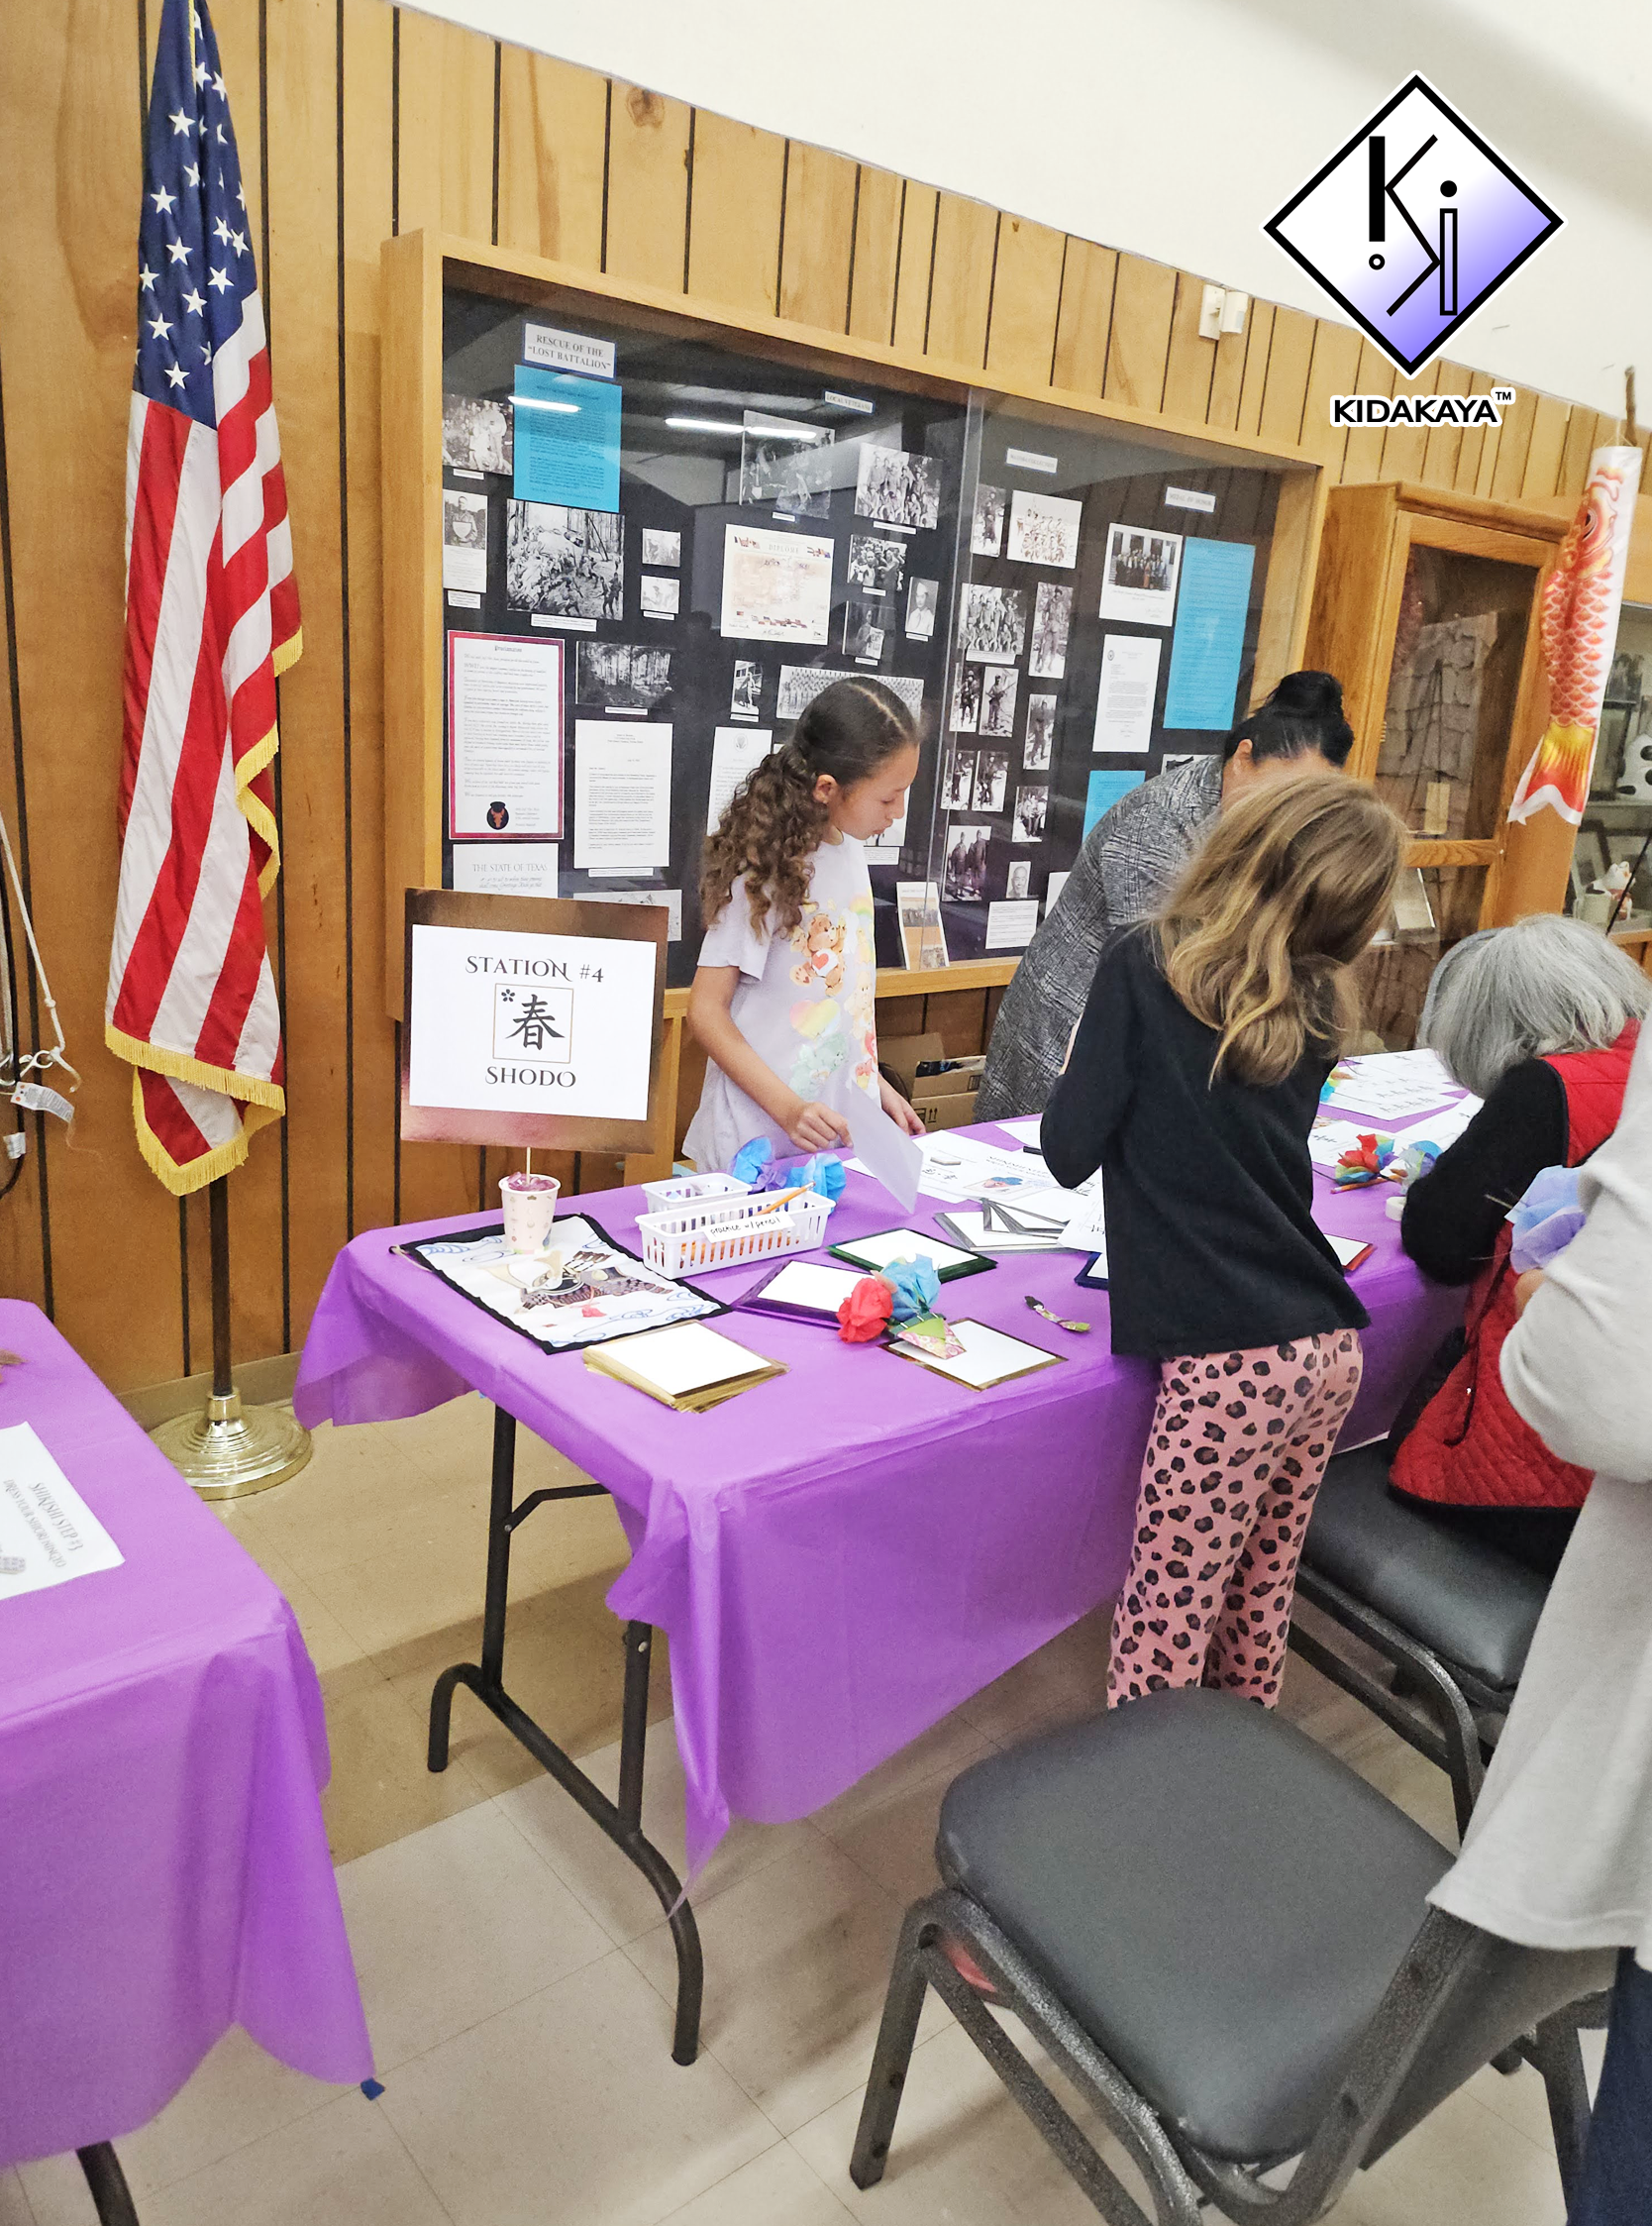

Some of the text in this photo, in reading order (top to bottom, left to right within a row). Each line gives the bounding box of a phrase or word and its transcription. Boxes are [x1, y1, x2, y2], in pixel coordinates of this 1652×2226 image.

[536, 335, 604, 358] RESCUE OF THE
[472, 863, 549, 873] THE STATE OF TEXAS
[465, 956, 604, 983] STATION #4
[505, 994, 566, 1051] 春
[485, 1066, 576, 1088] SHODO
[710, 1224, 741, 1237] practice
[756, 1216, 780, 1228] pencil
[29, 1482, 64, 1520] SHIKISHI
[52, 1519, 78, 1538] STEP
